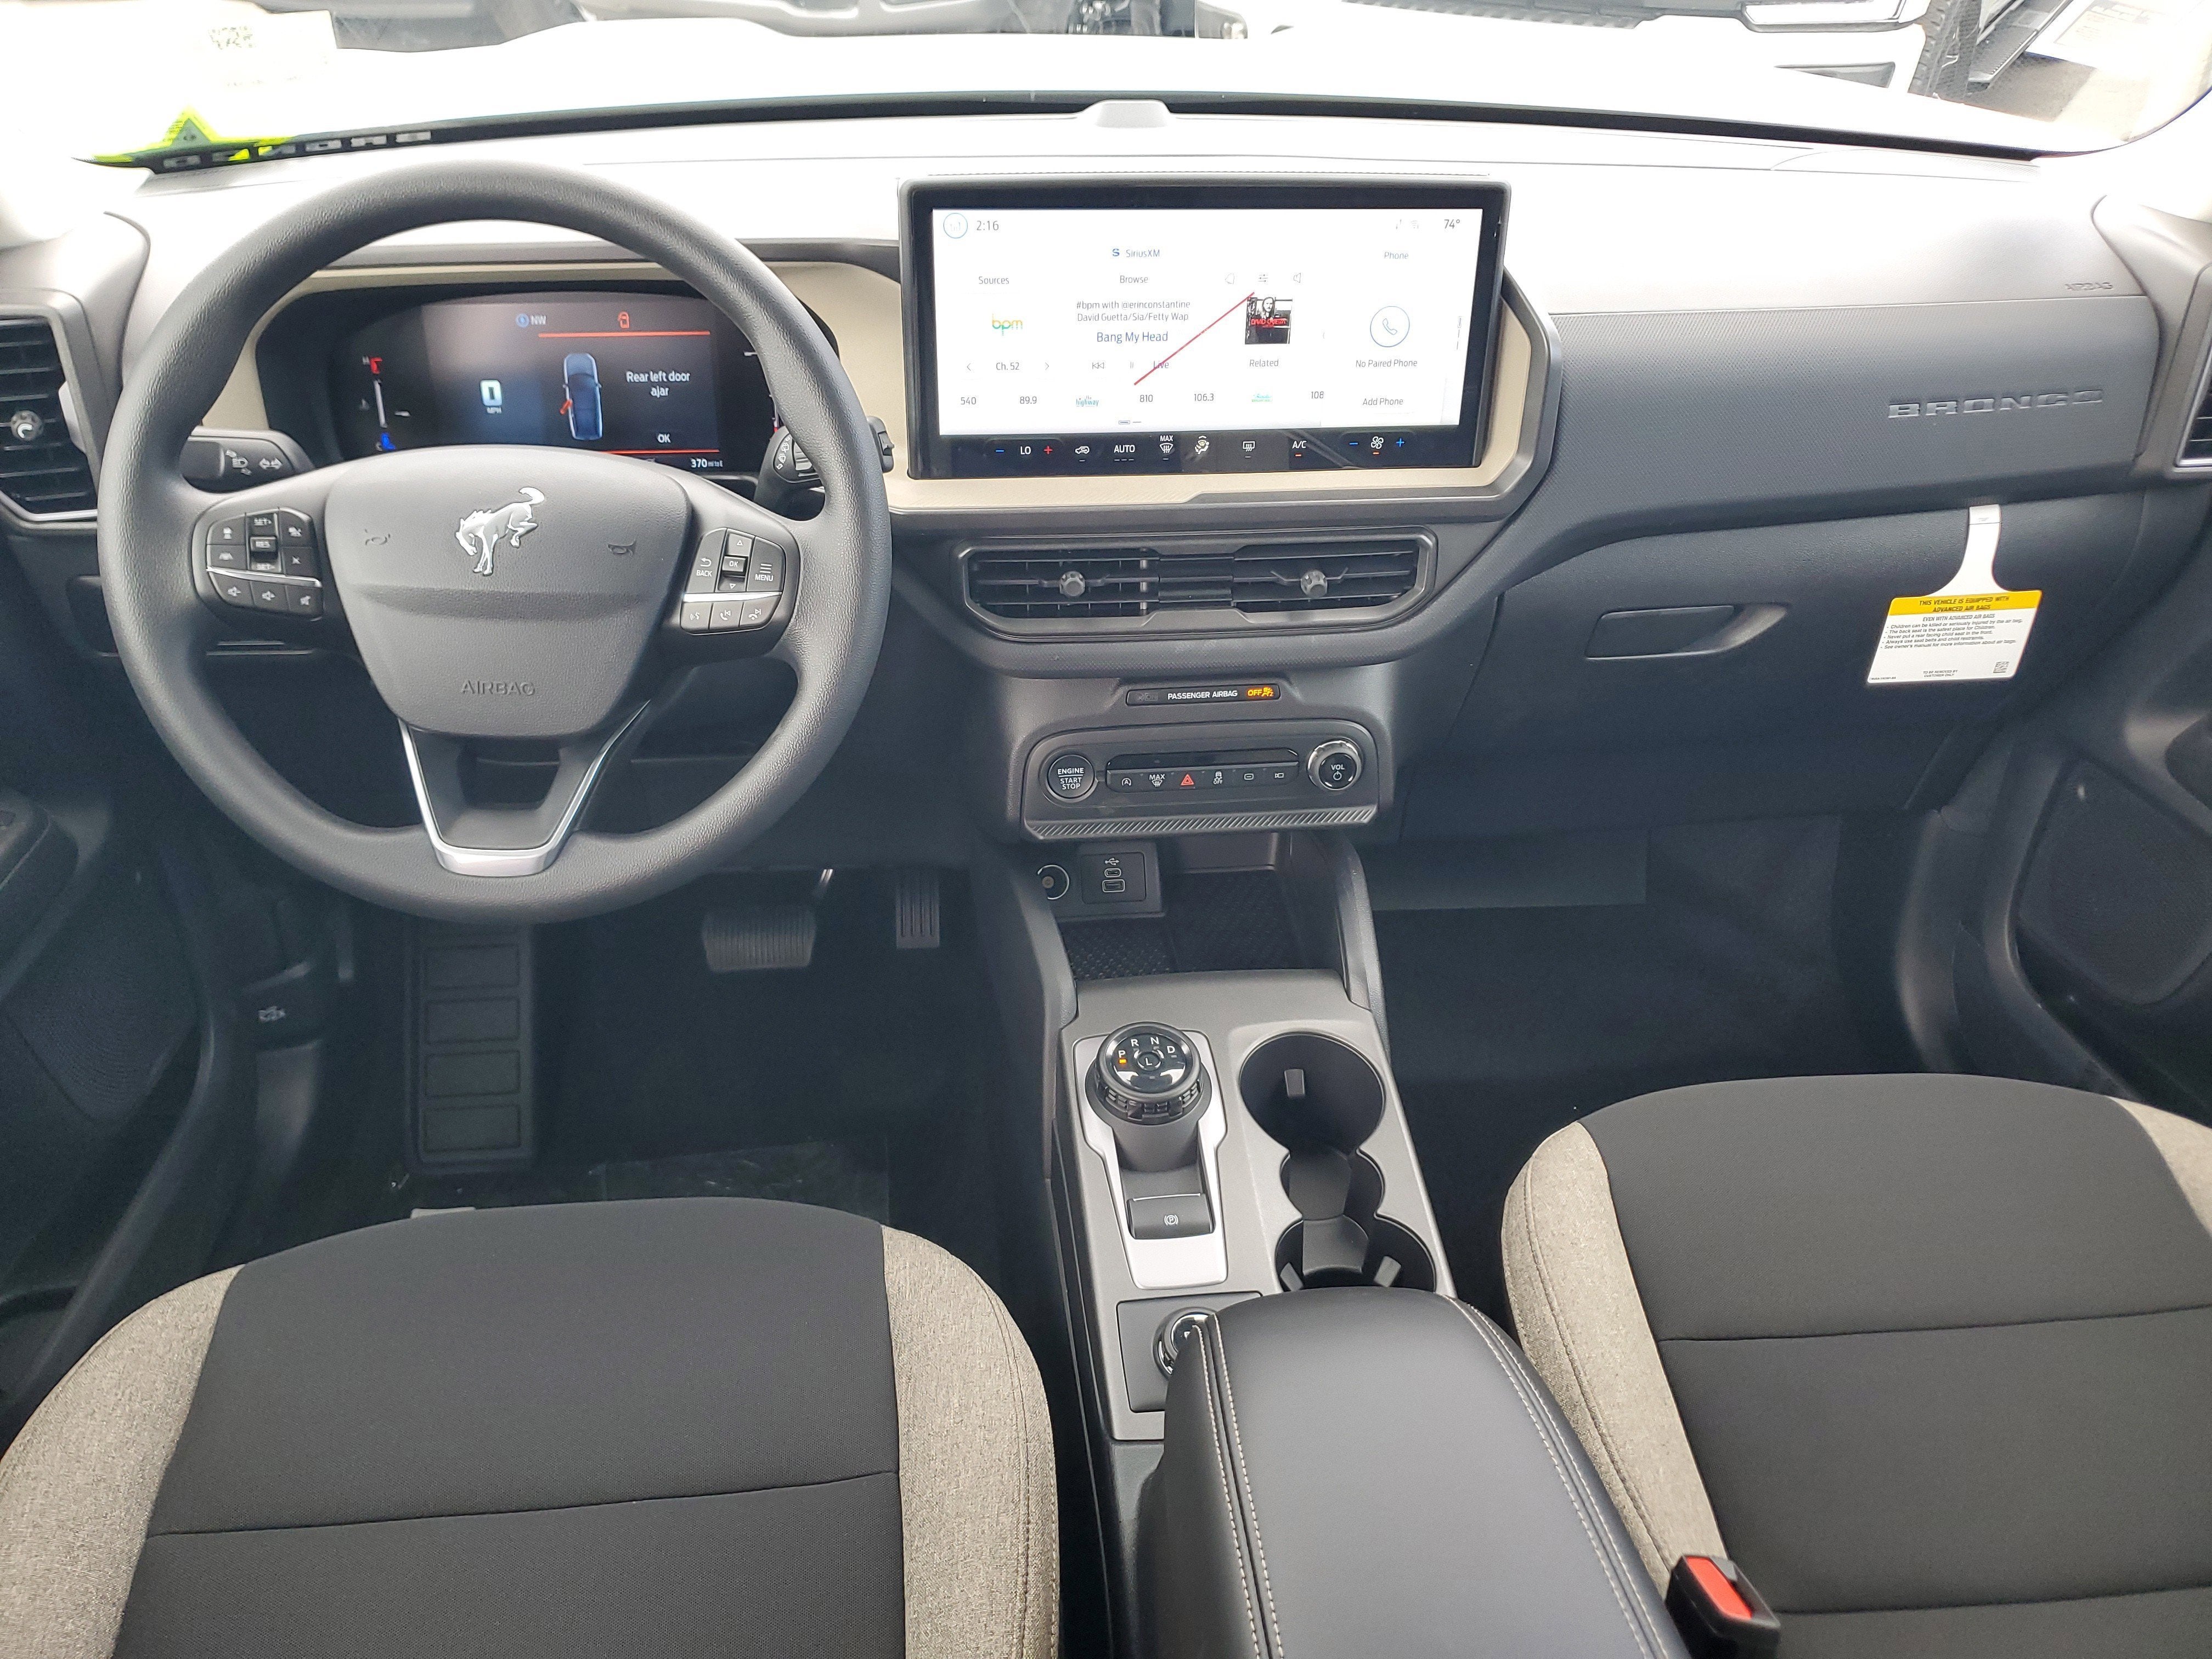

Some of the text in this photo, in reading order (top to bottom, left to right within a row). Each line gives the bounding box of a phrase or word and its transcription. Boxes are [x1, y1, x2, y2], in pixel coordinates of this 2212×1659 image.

[977, 221, 999, 230] 2:16
[1444, 219, 1460, 229] 74°
[1126, 249, 1160, 257] SiriusXM
[979, 276, 1009, 284] Sources
[1120, 275, 1149, 283] Browse
[1076, 301, 1100, 310] #bpm
[531, 315, 546, 325] NW
[1077, 312, 1189, 321] David Guetta/Sia/Fetty Wap
[992, 314, 1023, 336] bpm
[1097, 331, 1169, 343] Bang My Head
[996, 362, 1019, 370] Ch. 52
[1153, 360, 1169, 369] Live
[1249, 359, 1279, 367] Related
[1393, 359, 1418, 367] Phone
[626, 370, 691, 382] Rear left door
[480, 379, 503, 407] 0
[651, 385, 669, 398] ajar
[961, 397, 977, 405] 540
[1020, 396, 1037, 404] 89.9
[1139, 394, 1153, 403] 810
[1194, 393, 1214, 402] 106.3
[1076, 398, 1099, 407] highway
[1888, 389, 2103, 419] BRONCO
[658, 433, 671, 443] OK
[1114, 444, 1135, 453] AUTO
[1292, 441, 1307, 449] A/C
[1020, 446, 1031, 455] LO
[691, 458, 708, 468] 370
[755, 574, 774, 582] MENU
[461, 680, 535, 696] AIRBAG
[1168, 691, 1211, 700] PASSENGER
[1131, 1039, 1139, 1047] R
[1150, 1036, 1159, 1045] N
[1118, 1050, 1126, 1058] P
[1145, 1057, 1153, 1066] L
